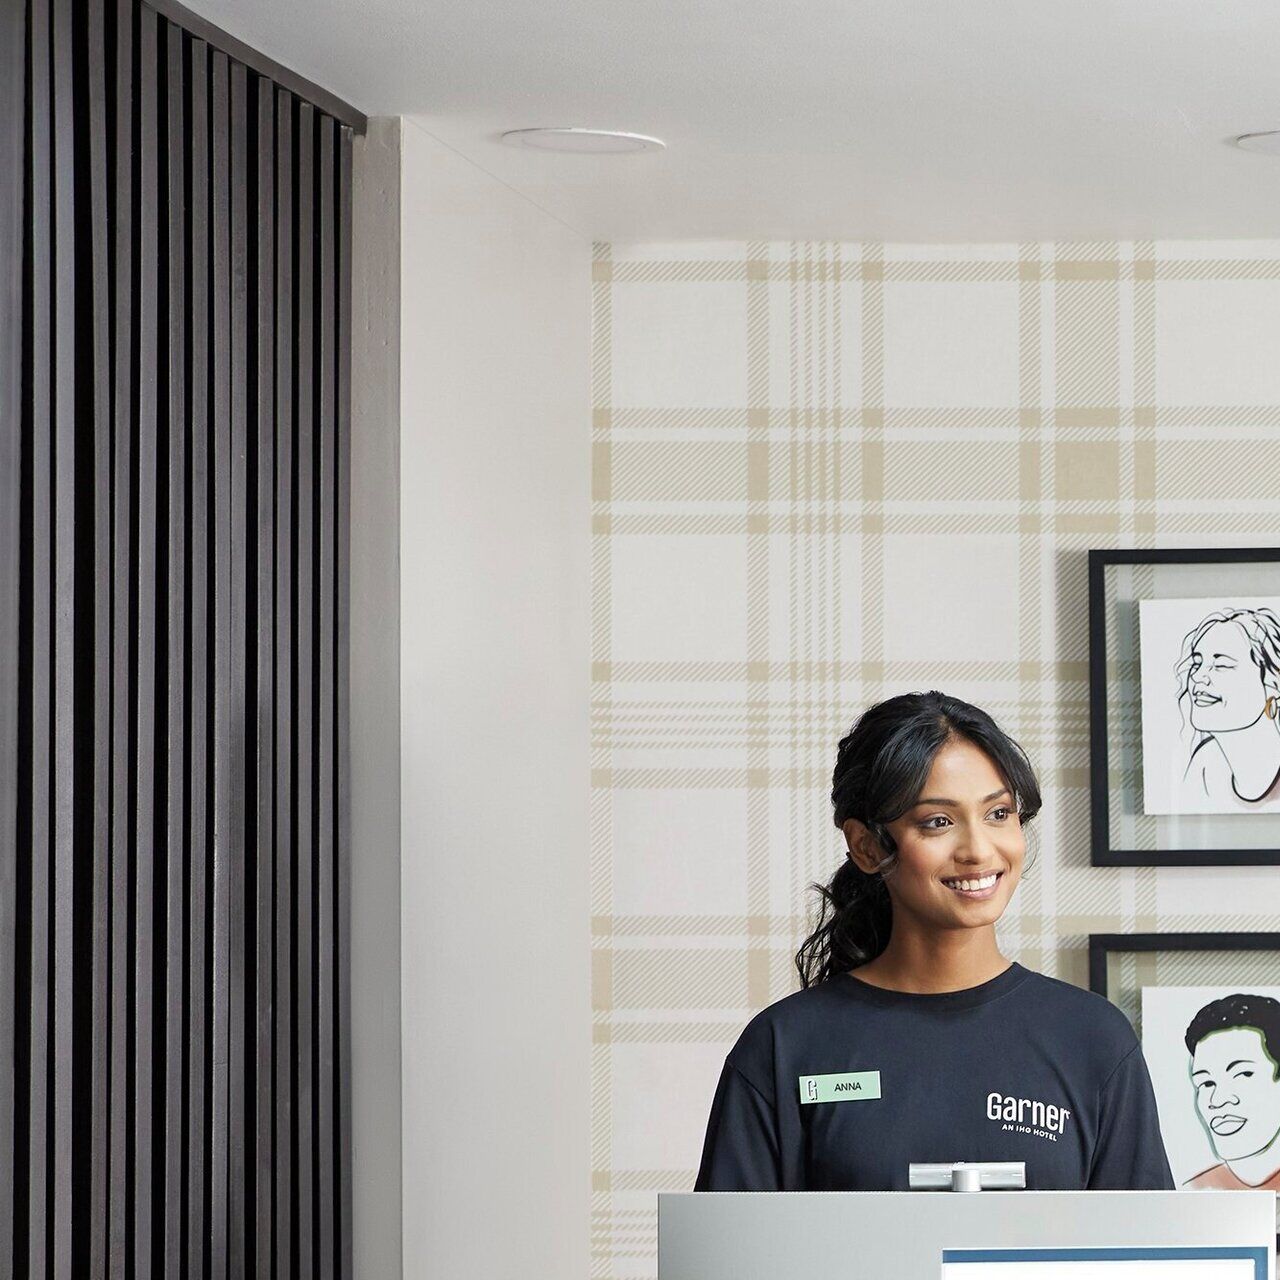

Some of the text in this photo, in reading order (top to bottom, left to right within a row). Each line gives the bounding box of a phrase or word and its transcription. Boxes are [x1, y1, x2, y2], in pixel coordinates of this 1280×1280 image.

[834, 1082, 862, 1092] ANNA
[987, 1092, 1071, 1134] Garner
[1002, 1123, 1014, 1131] AN
[1033, 1128, 1057, 1141] HOTEL
